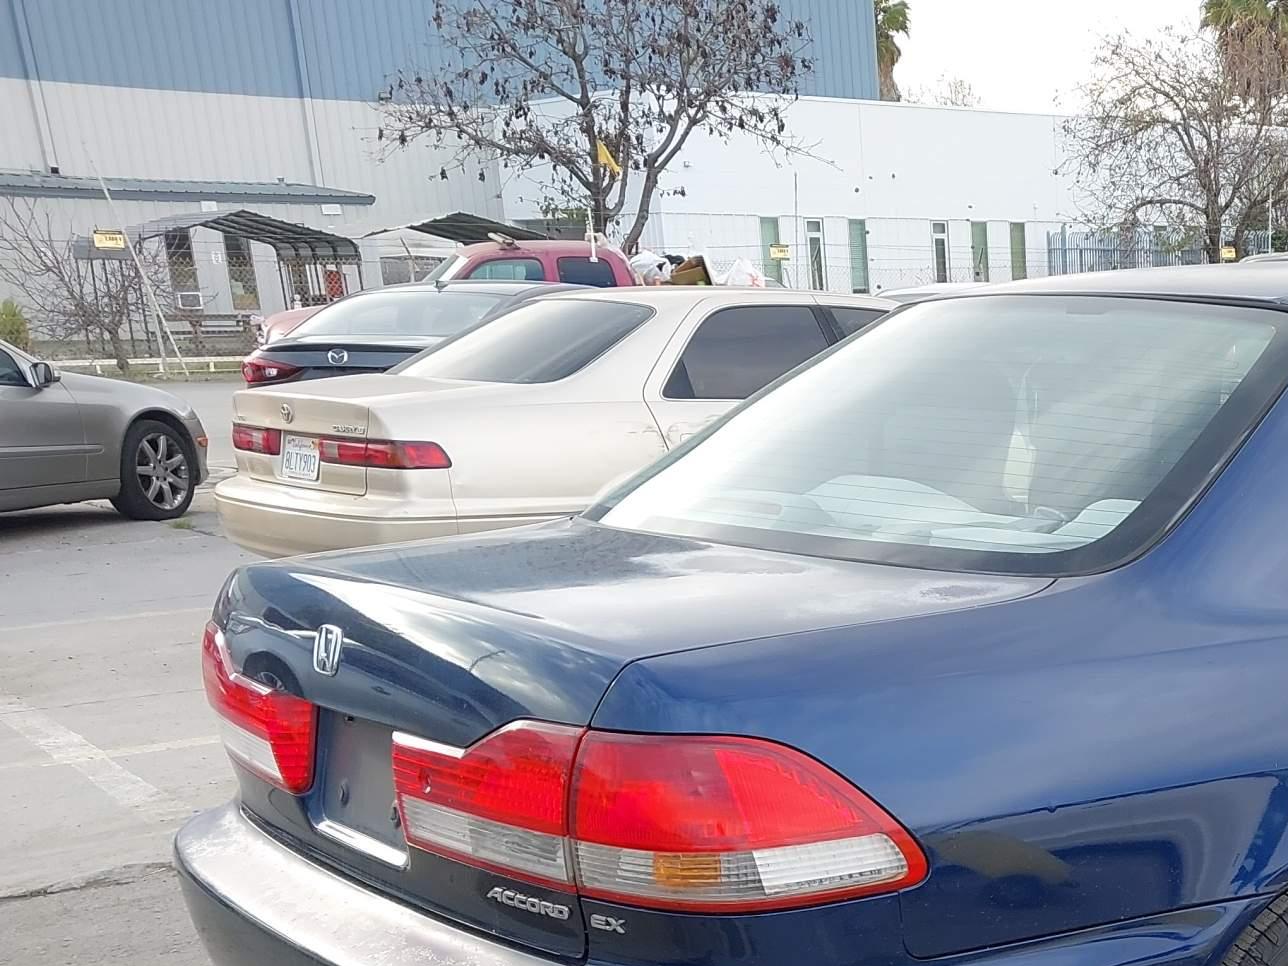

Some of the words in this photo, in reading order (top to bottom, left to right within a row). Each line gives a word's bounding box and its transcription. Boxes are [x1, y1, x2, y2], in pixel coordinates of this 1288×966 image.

[284, 450, 316, 473] 8LTY903
[486, 886, 571, 920] ACCORD
[590, 914, 626, 934] EX
